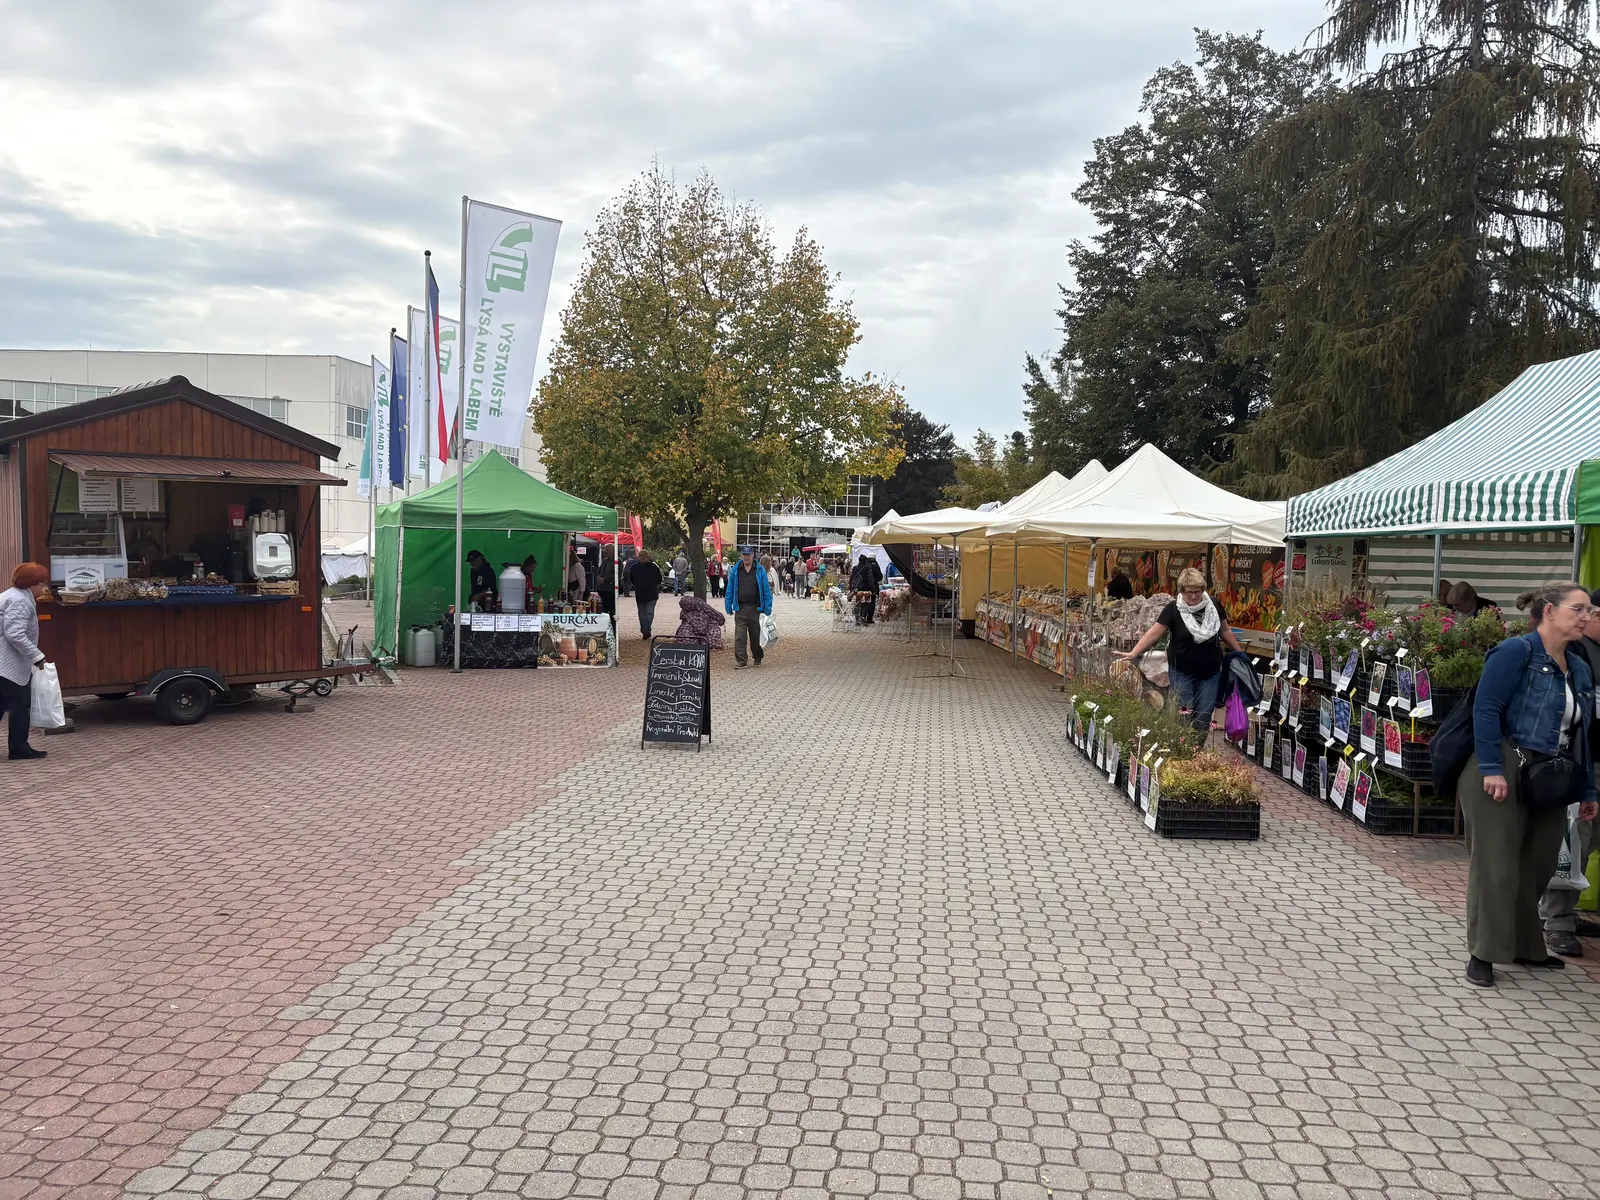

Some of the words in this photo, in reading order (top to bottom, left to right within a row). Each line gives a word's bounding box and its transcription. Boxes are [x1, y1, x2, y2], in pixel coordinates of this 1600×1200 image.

[477, 297, 494, 336] LYSÁ
[472, 341, 487, 374] NAD
[488, 323, 516, 418] VÝSTAVIŠTĚ
[464, 378, 483, 431] LABEM
[377, 432, 385, 454] NAD
